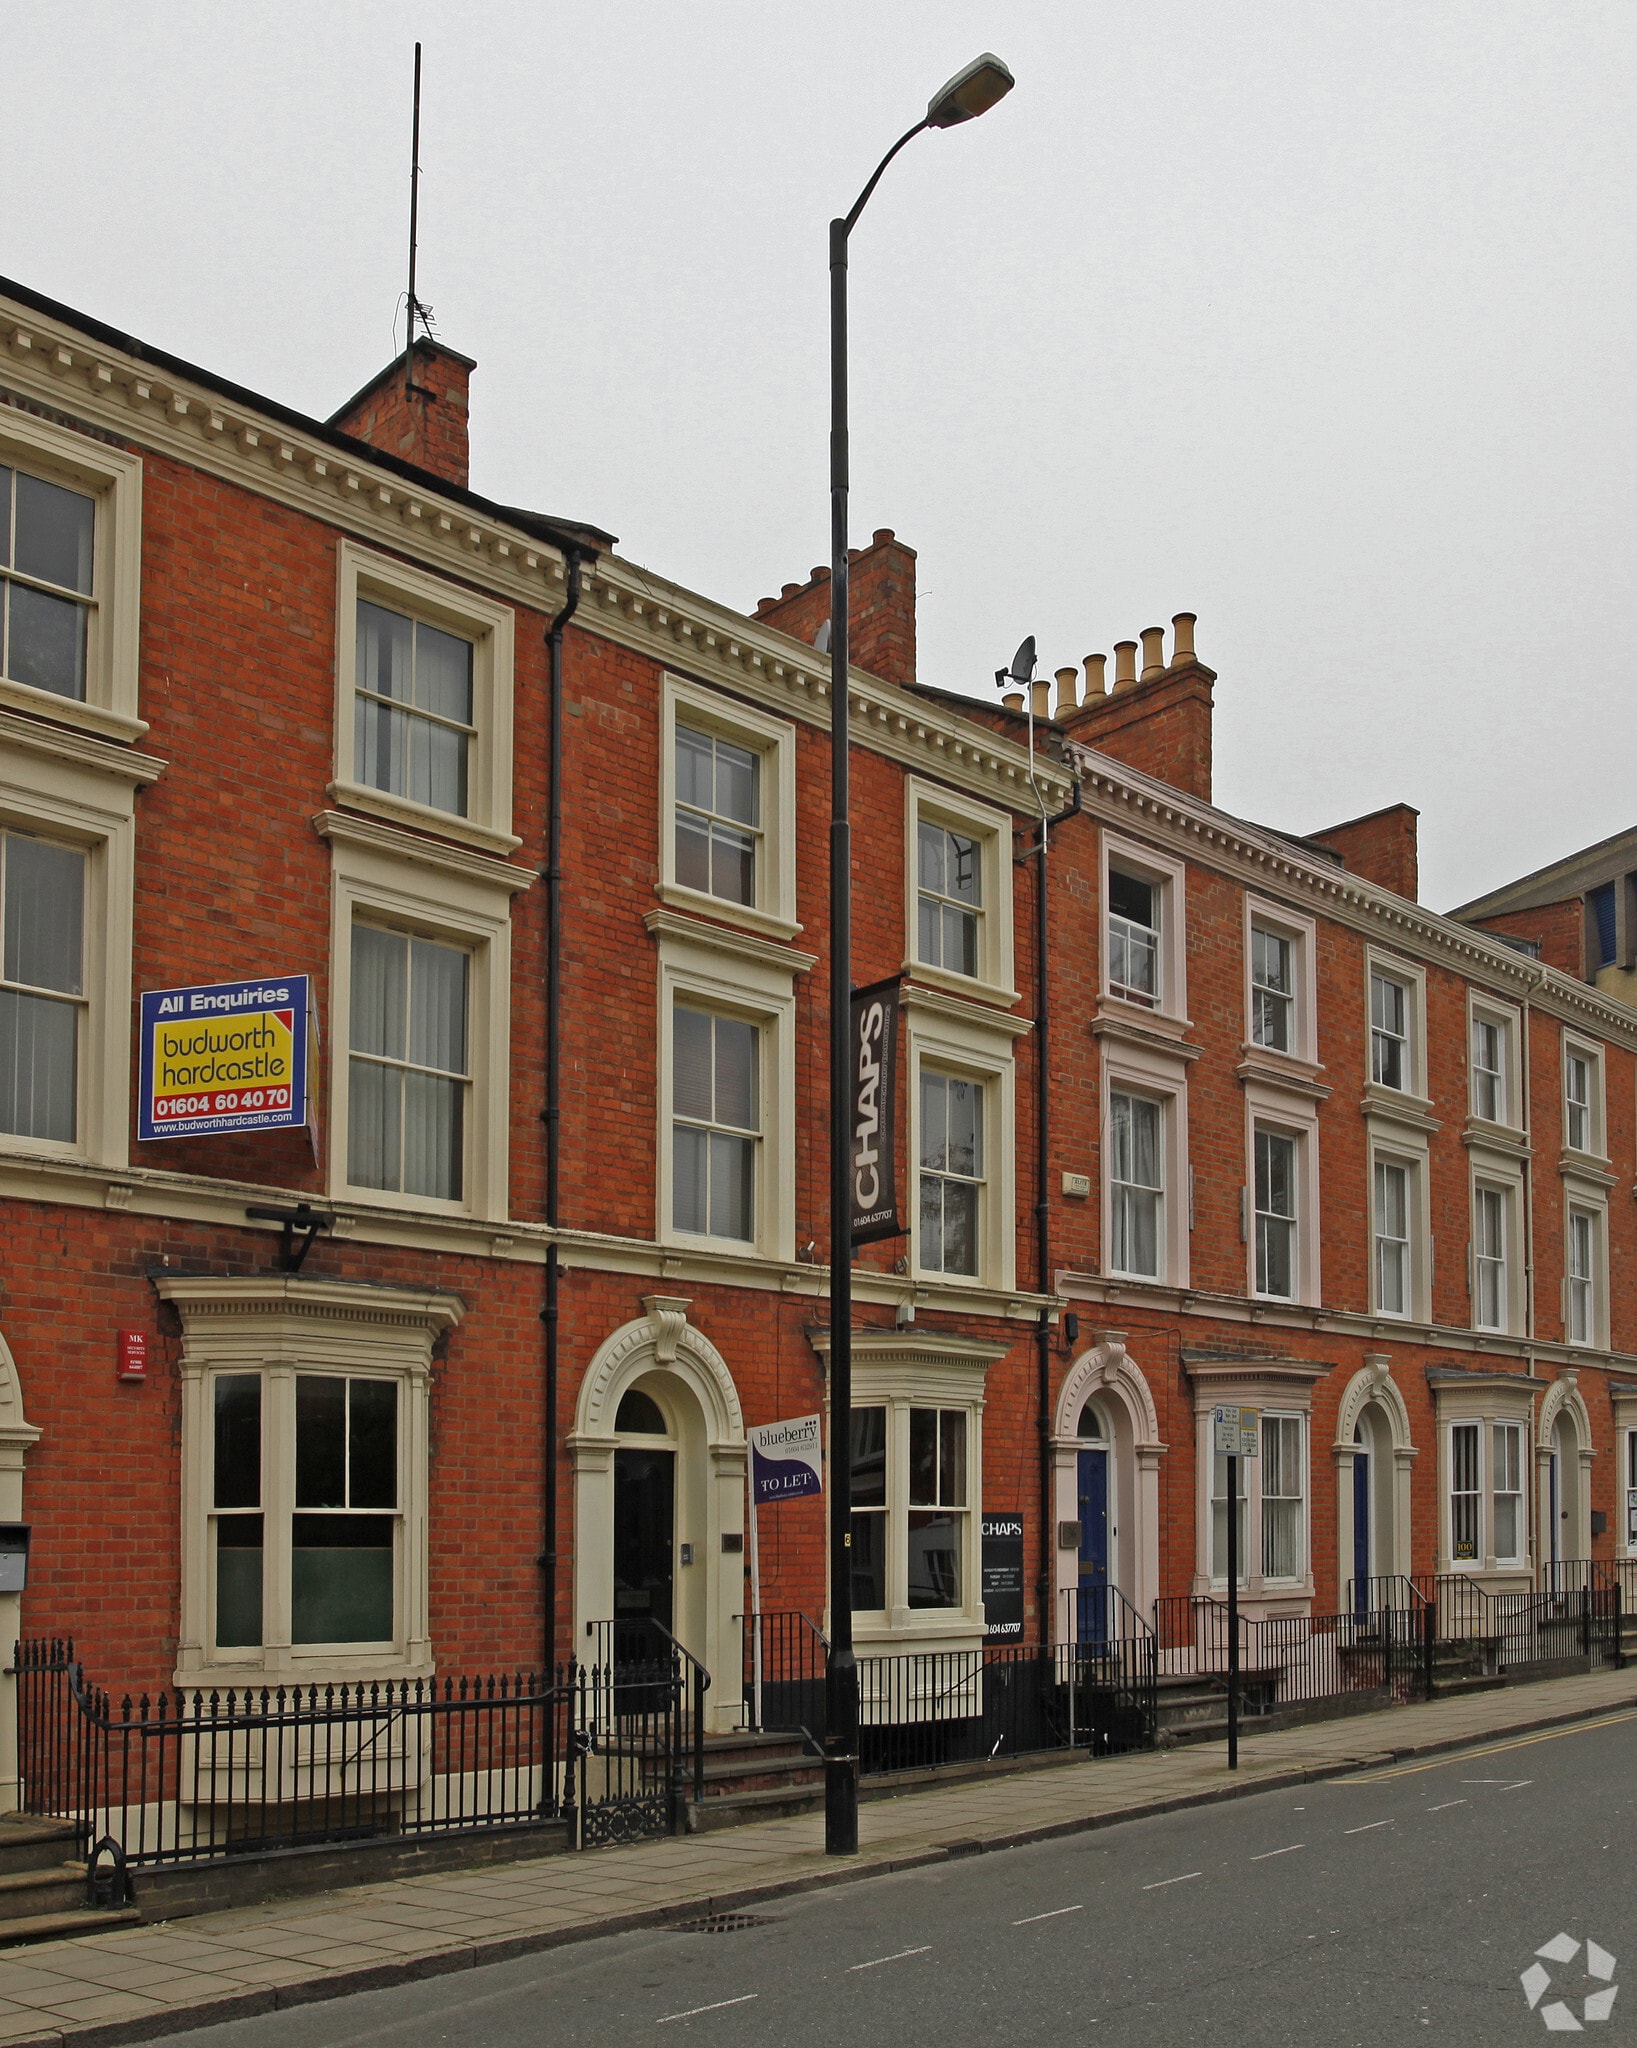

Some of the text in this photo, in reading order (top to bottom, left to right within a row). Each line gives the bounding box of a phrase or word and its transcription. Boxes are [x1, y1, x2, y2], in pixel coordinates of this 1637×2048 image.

[158, 987, 290, 1015] All Enquiries
[163, 1012, 275, 1058] budworth
[163, 1052, 285, 1087] hardcastle
[156, 1088, 288, 1116] 01604 60 40 70
[855, 1001, 883, 1210] CHAPS
[153, 1112, 293, 1133] www.budworthhardcastle.com
[853, 1209, 893, 1227] 01604 637707
[129, 1334, 143, 1343] MK
[760, 1426, 817, 1447] blueberry
[761, 1472, 810, 1492] TO LET
[981, 1522, 1022, 1535] CHAPS
[1457, 1543, 1472, 1552] 100
[1001, 1622, 1021, 1633] 637707
